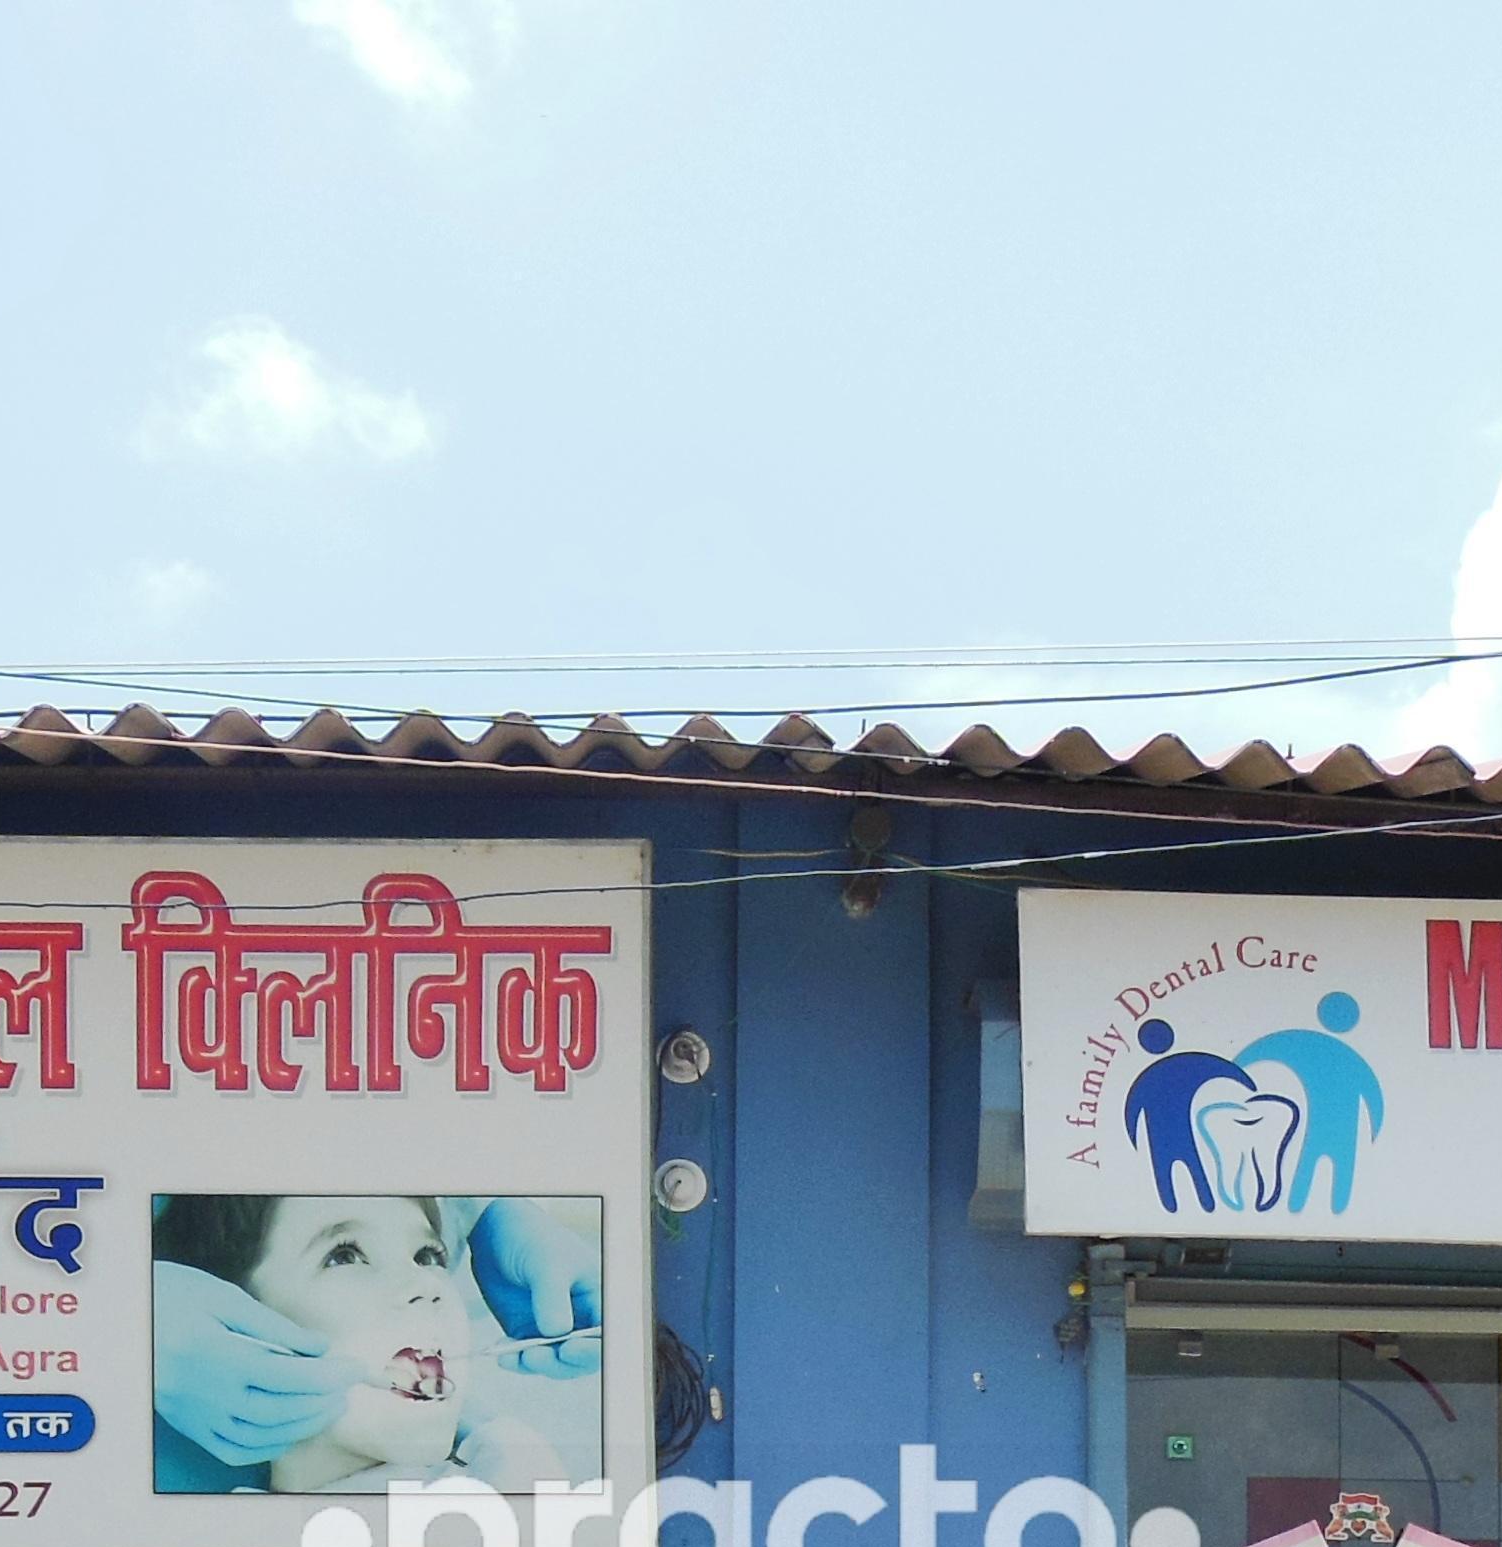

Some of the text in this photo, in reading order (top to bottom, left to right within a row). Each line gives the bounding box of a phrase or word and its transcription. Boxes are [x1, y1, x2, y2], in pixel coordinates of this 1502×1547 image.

[121, 871, 612, 1091] क्लिनिक
[1066, 935, 1318, 1169] A family Dental Care
[2, 1412, 74, 1439] तक
